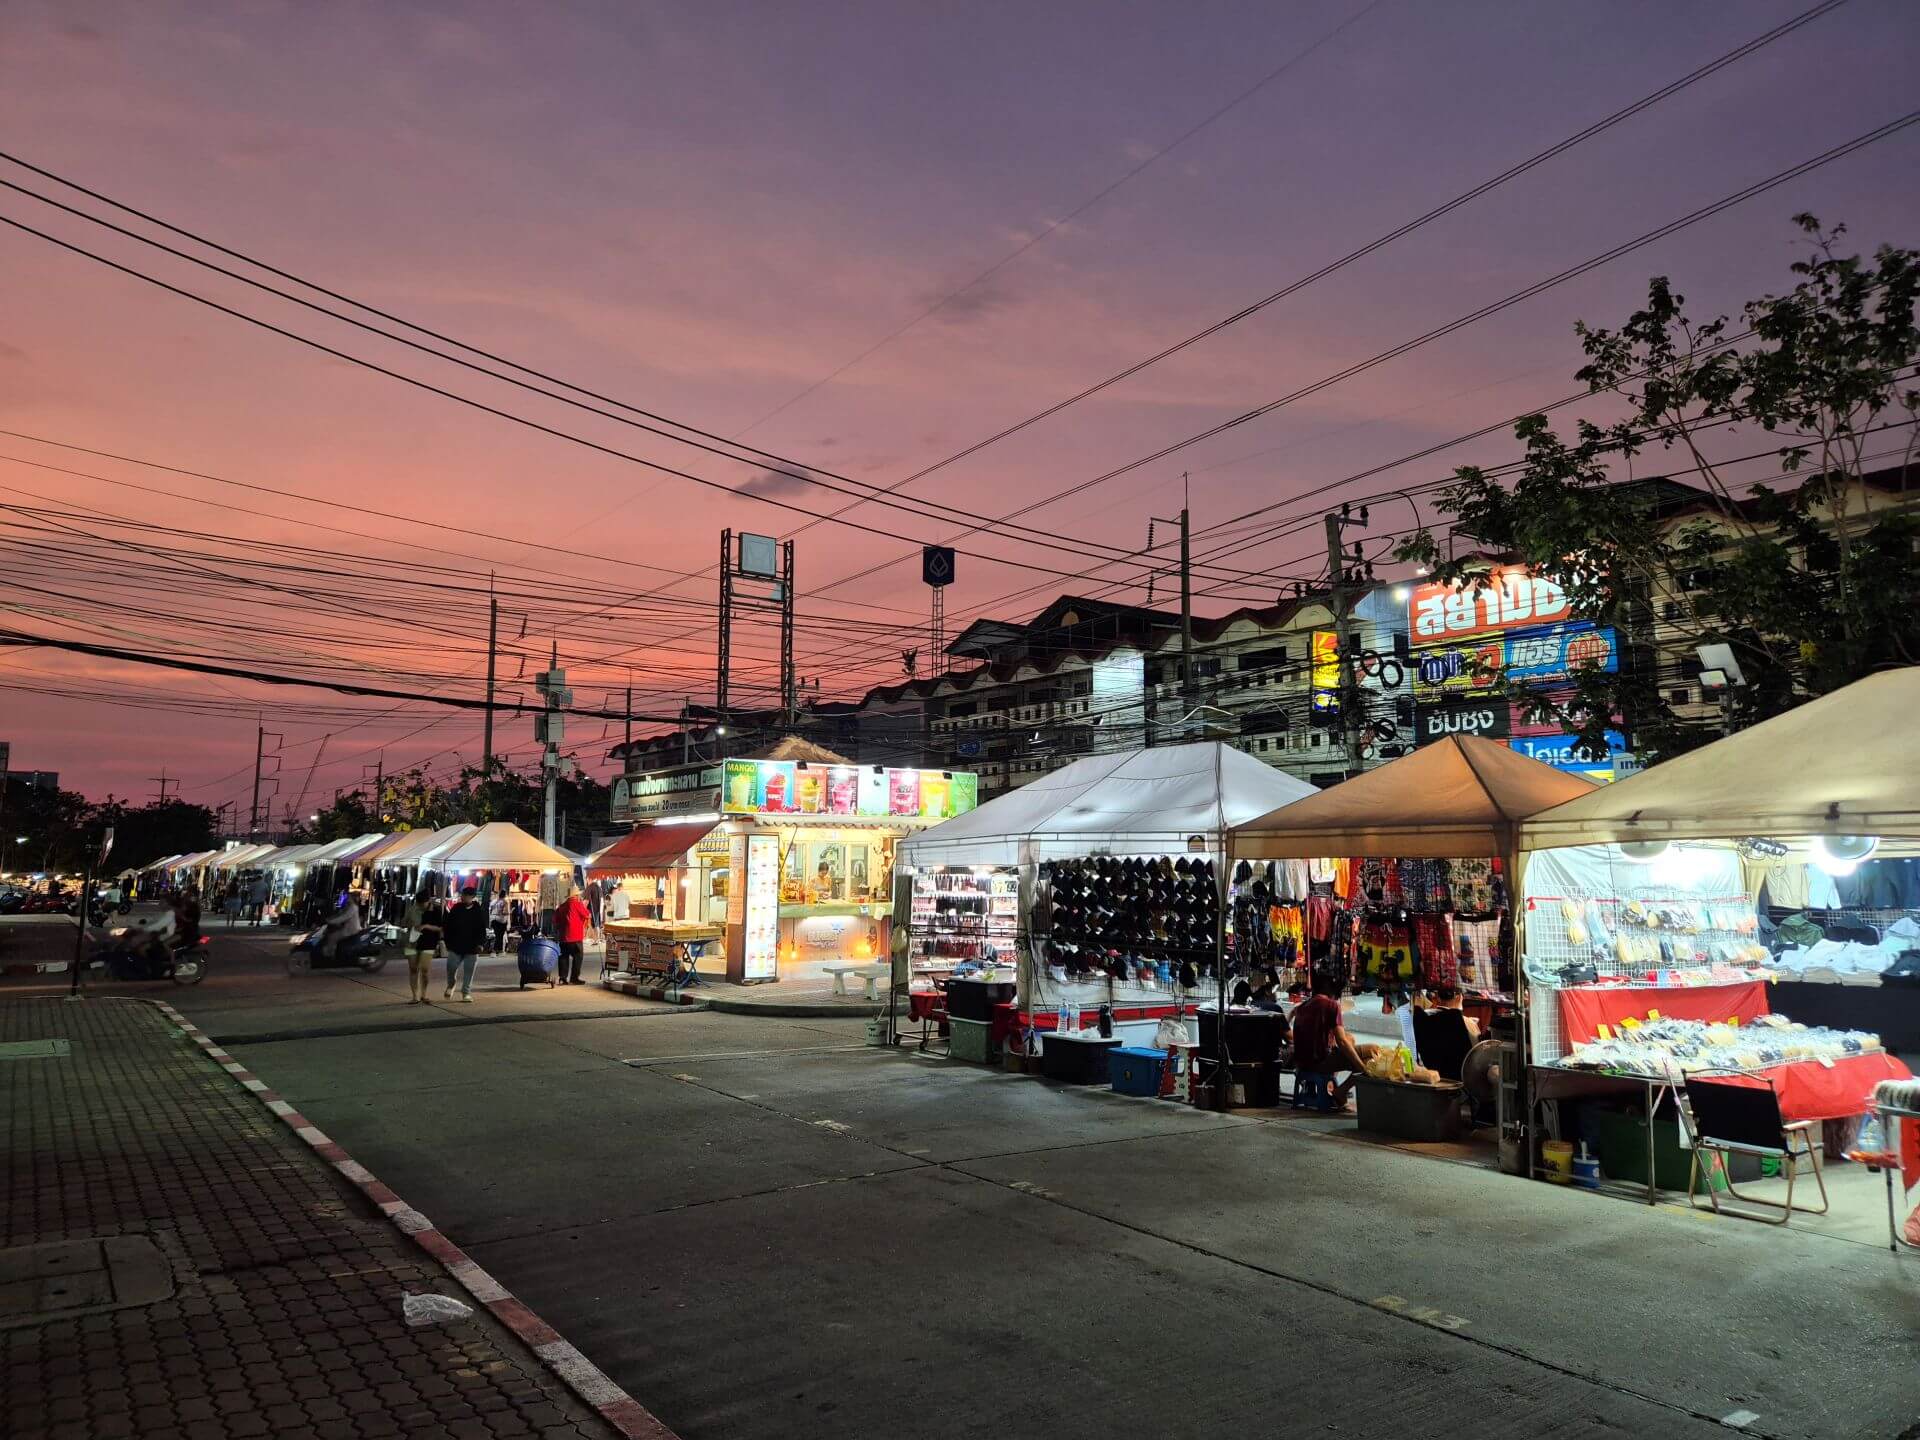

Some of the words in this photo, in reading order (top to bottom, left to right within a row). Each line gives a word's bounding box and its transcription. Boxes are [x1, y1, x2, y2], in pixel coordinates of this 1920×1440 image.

[1427, 709, 1494, 736] ซัมซุง
[727, 763, 755, 773] MANGO
